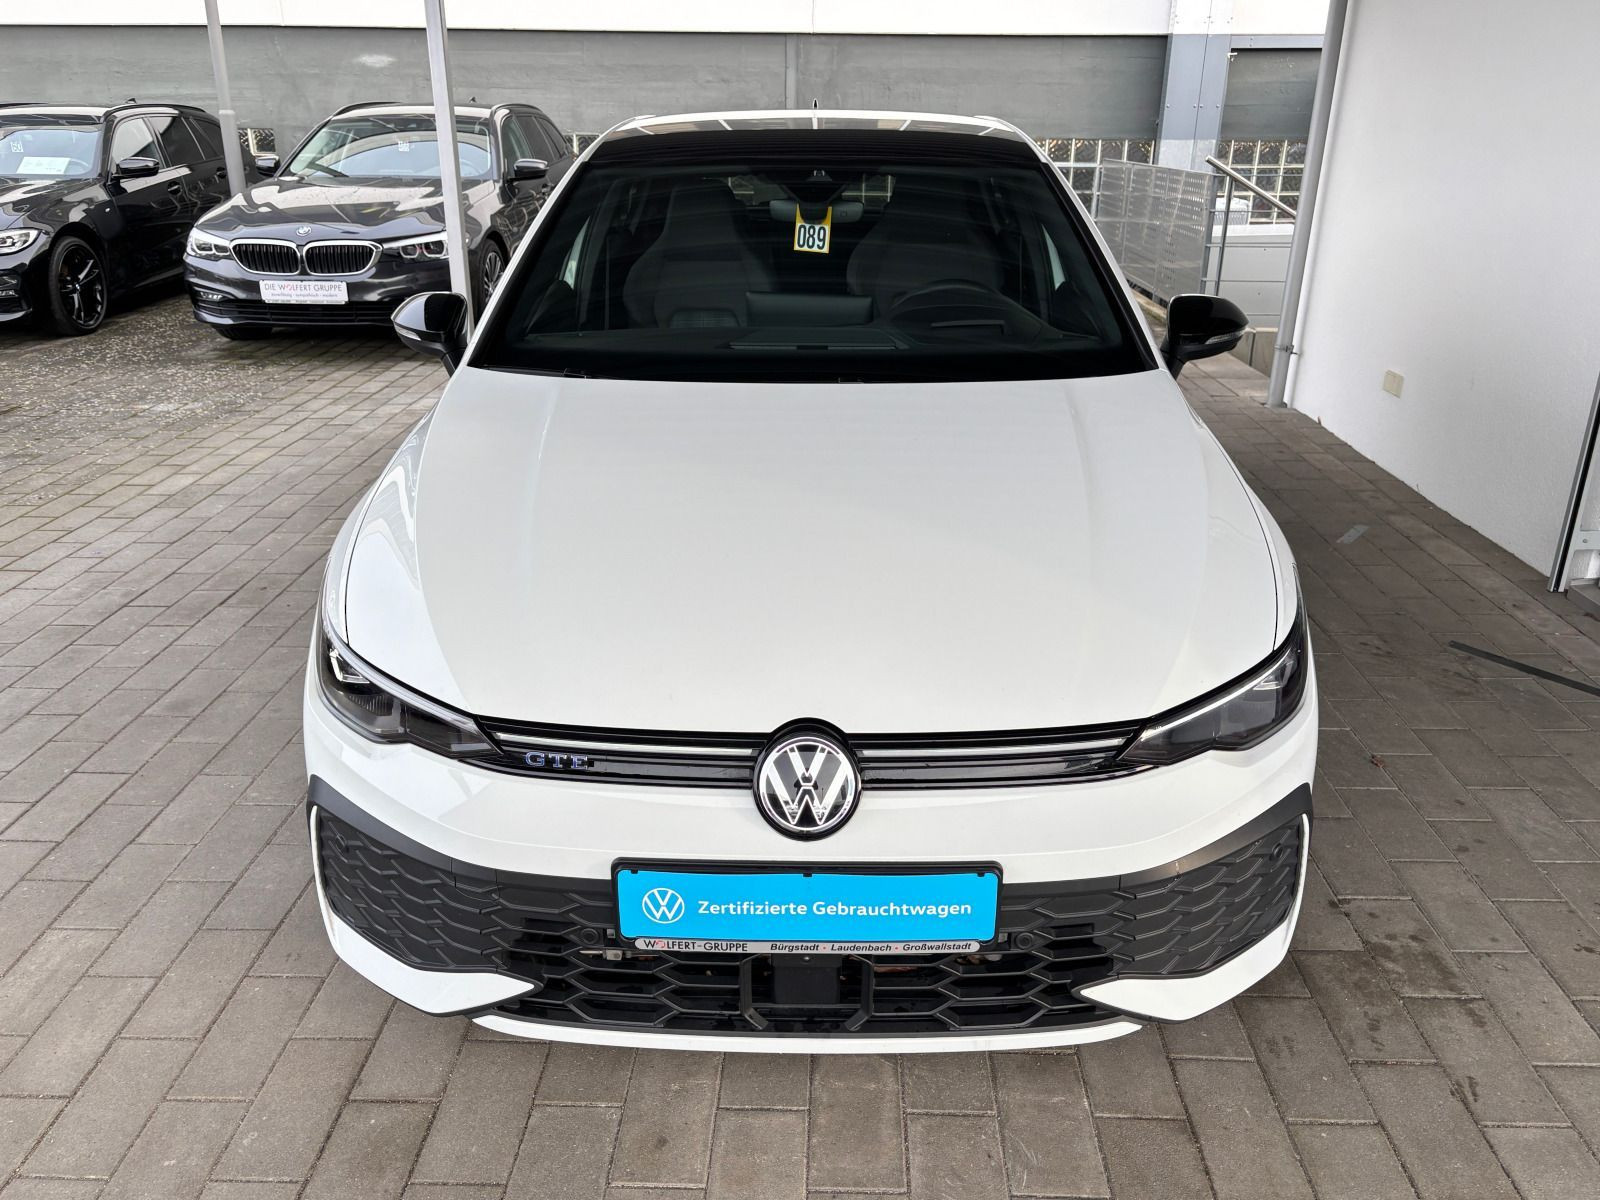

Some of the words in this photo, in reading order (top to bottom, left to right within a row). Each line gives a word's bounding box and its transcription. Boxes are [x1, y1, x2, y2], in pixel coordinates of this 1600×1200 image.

[797, 224, 826, 250] 089
[264, 283, 276, 291] DIE
[313, 284, 343, 292] GRUPPE
[525, 751, 588, 770] GTE
[698, 901, 807, 915] Zertifizierte
[813, 901, 972, 917] Gebrauchtwagen
[770, 943, 820, 952] Bürgstadt
[830, 944, 892, 952] Laudenbach
[902, 942, 972, 952] Großwallstadt
